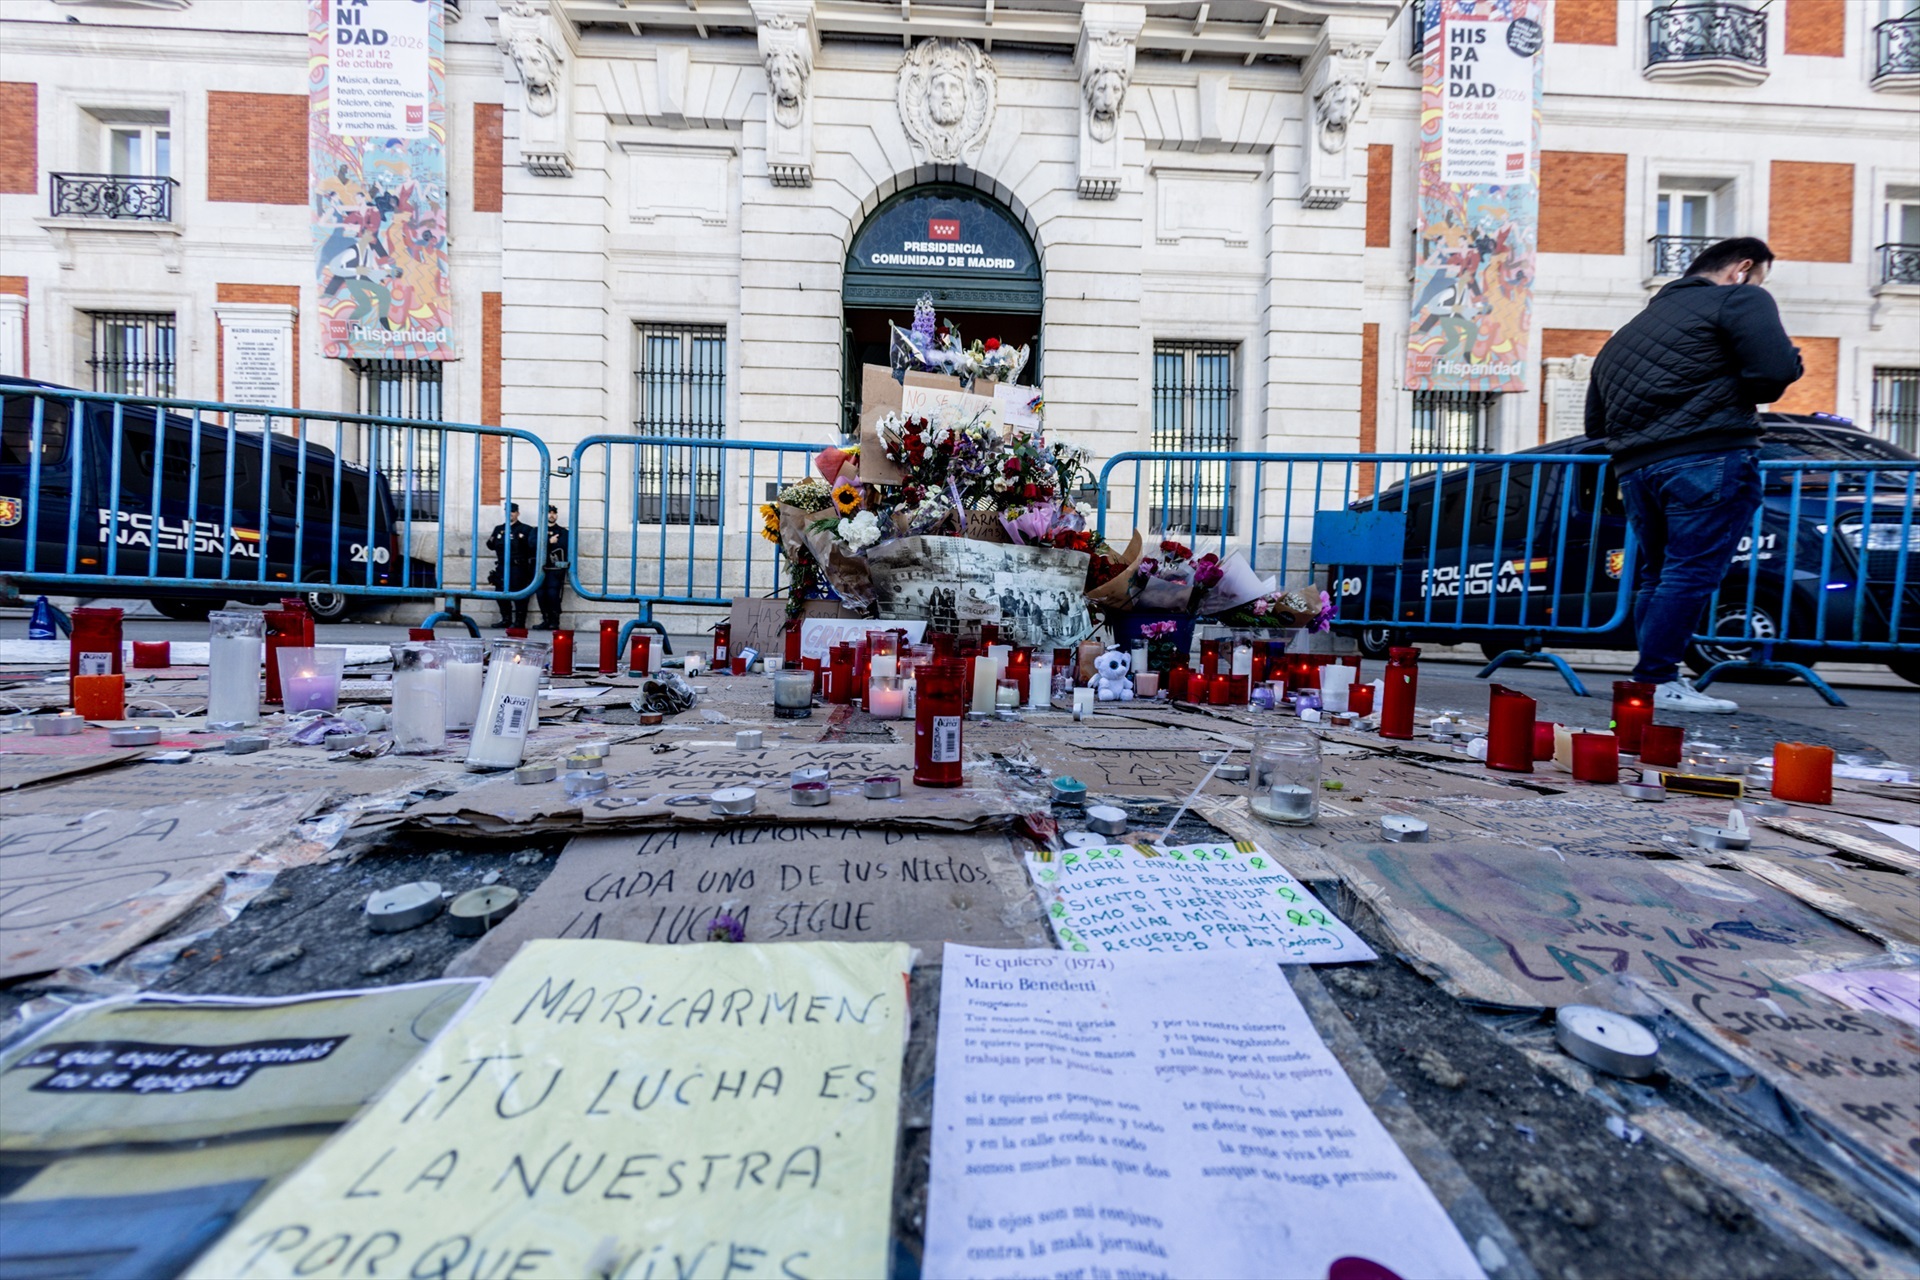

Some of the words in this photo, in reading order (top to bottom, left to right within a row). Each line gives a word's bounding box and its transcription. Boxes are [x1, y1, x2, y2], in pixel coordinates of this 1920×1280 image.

[337, 9, 361, 26] NI
[337, 28, 389, 46] DAD
[390, 35, 424, 50] 2026
[1451, 28, 1487, 44] HIS
[337, 49, 354, 59] Del
[357, 50, 363, 59] 2
[366, 49, 375, 59] al
[379, 50, 391, 60] 12
[1451, 47, 1479, 62] PA
[337, 59, 351, 69] de
[353, 60, 393, 70] octubre
[1450, 64, 1472, 80] NI
[1450, 83, 1496, 99] DAD
[1448, 101, 1464, 111] Del
[1487, 101, 1497, 111] 12
[903, 241, 984, 255] PRESIDENCIA
[871, 253, 945, 267] COMUNIDAD
[948, 256, 965, 268] DE
[968, 257, 1016, 270] MADRID
[354, 325, 447, 346] Hispanidad
[1437, 360, 1523, 377] Hispanidad
[907, 390, 927, 410] NO
[1421, 560, 1517, 582] POLICA
[1132, 859, 1211, 873] CARMEN
[1215, 862, 1249, 873] TU
[584, 868, 676, 903] CADA
[696, 866, 757, 895] UNO
[780, 863, 823, 893] DE
[1135, 873, 1161, 885] ES
[1169, 873, 1197, 884] UN
[1154, 886, 1183, 899] TU
[767, 899, 876, 939] SIGUE
[1064, 908, 1125, 929] COMO
[1162, 896, 1227, 911] FUERA
[1233, 899, 1264, 912] UN
[1101, 930, 1197, 953] RECUERDO
[1064, 957, 1115, 972] (1974)
[964, 976, 1014, 991] Mario
[1019, 977, 1097, 992] Benedetti
[980, 1038, 1021, 1050] quiero
[1024, 1054, 1047, 1067] por
[583, 1062, 785, 1118] LUCHA
[817, 1063, 878, 1105] ES
[979, 1137, 999, 1150] en
[1002, 1135, 1018, 1150] la
[342, 1145, 460, 1201] LA
[492, 1140, 823, 1201] NUESTRA
